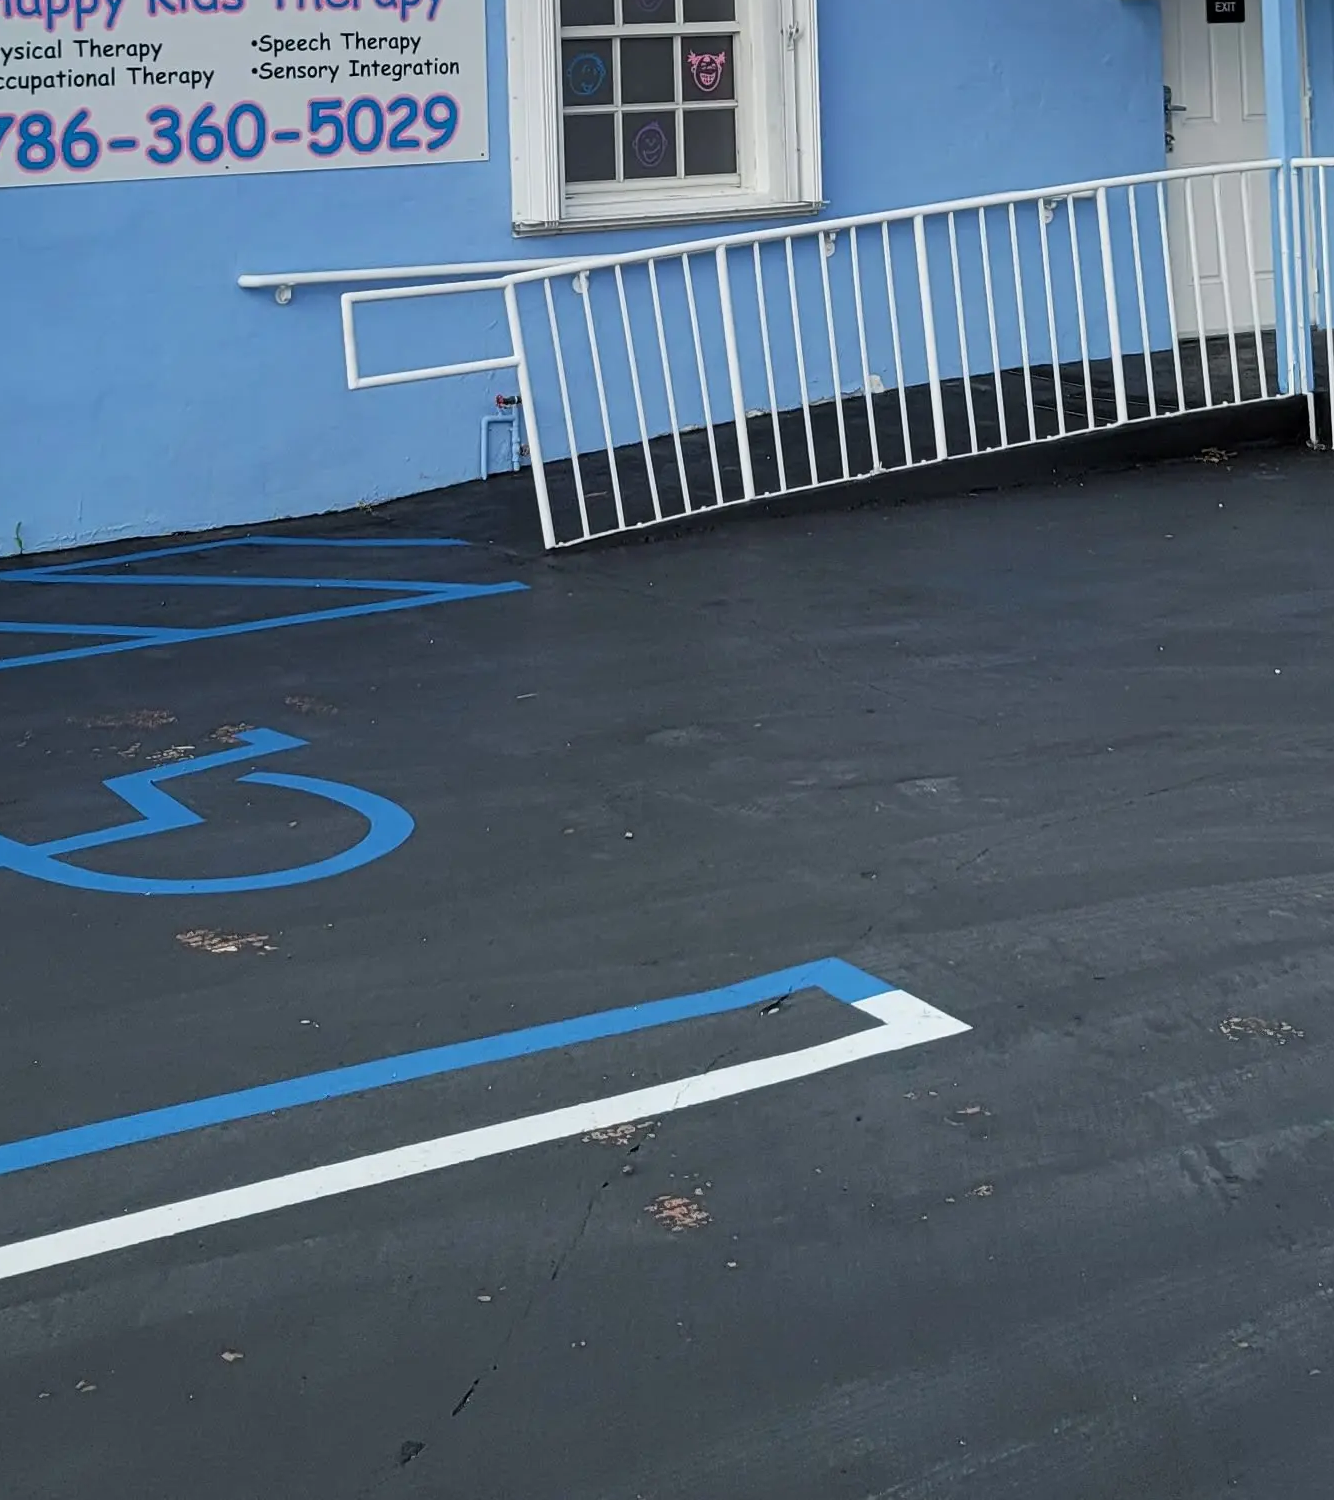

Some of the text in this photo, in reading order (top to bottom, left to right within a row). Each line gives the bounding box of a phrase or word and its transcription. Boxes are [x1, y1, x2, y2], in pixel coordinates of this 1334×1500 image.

[1214, 1, 1237, 13] EXIT
[73, 38, 163, 63] Therapy
[340, 31, 421, 55] Therapy
[126, 66, 215, 90] Therapy
[348, 57, 460, 81] Integration
